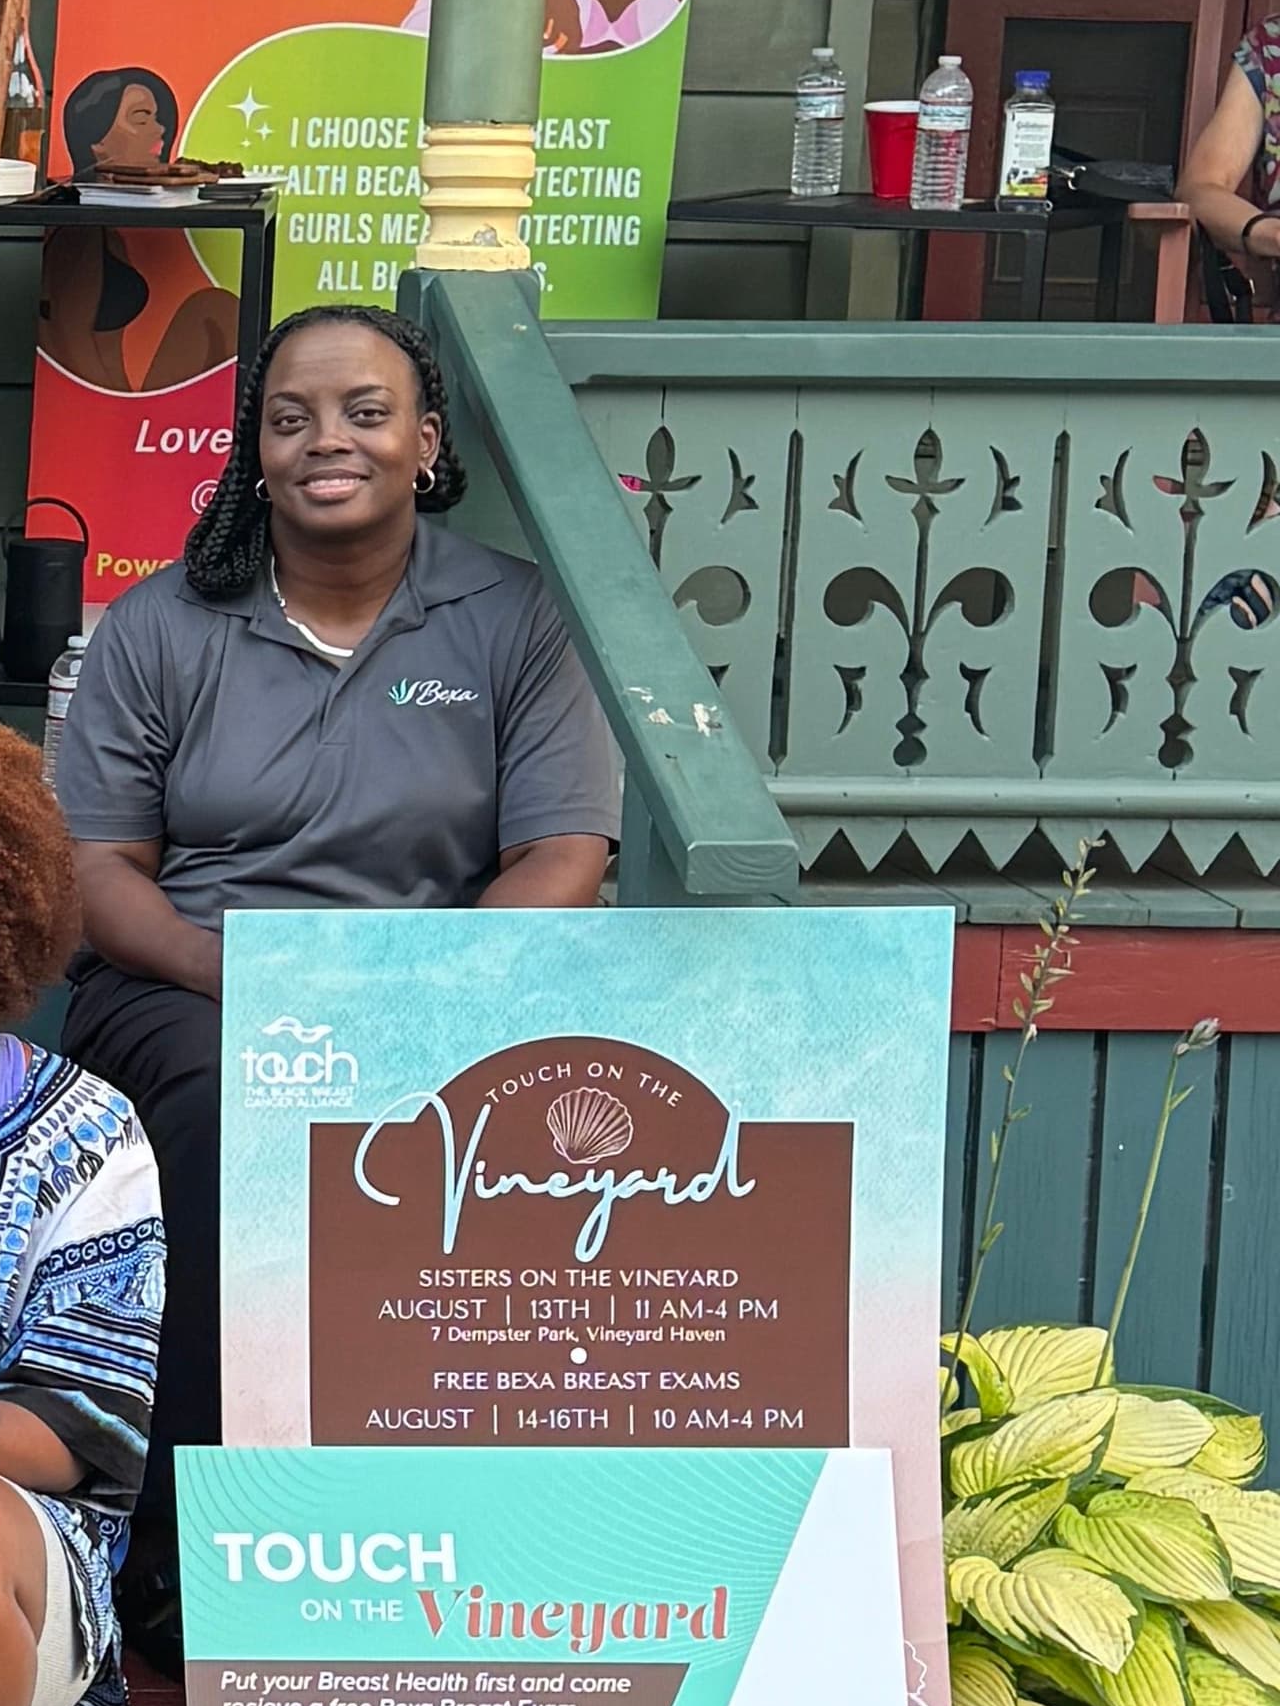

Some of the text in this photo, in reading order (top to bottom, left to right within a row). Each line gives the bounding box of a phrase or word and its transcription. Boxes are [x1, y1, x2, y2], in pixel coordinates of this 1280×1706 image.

[291, 117, 299, 148] I
[306, 117, 410, 149] CHOOSE
[356, 165, 642, 198] BECA TECTING
[289, 213, 373, 244] GURLS
[317, 260, 363, 291] ALL
[134, 419, 234, 454] Love
[415, 679, 479, 706] Bexa
[240, 1039, 359, 1084] touch
[485, 1062, 685, 1109] TOUCH ON THE
[354, 1091, 756, 1263] Vineyard
[418, 1269, 739, 1288] SISTERS ON THE VINEYARD
[378, 1299, 779, 1321] AUGUST 13TH 11 AM-4 PM
[432, 1326, 726, 1345] 7 Dempster Park, Vineyard Haven
[433, 1372, 741, 1391] FREE BEXA BREAST EXAMS
[365, 1408, 804, 1430] AUGUST 14-16TH 10 AM-4 PM
[213, 1532, 457, 1583] TOUCH
[300, 1584, 729, 1654] ON THE Vineyard
[220, 1671, 632, 1696] Put your Breast Health first and come
